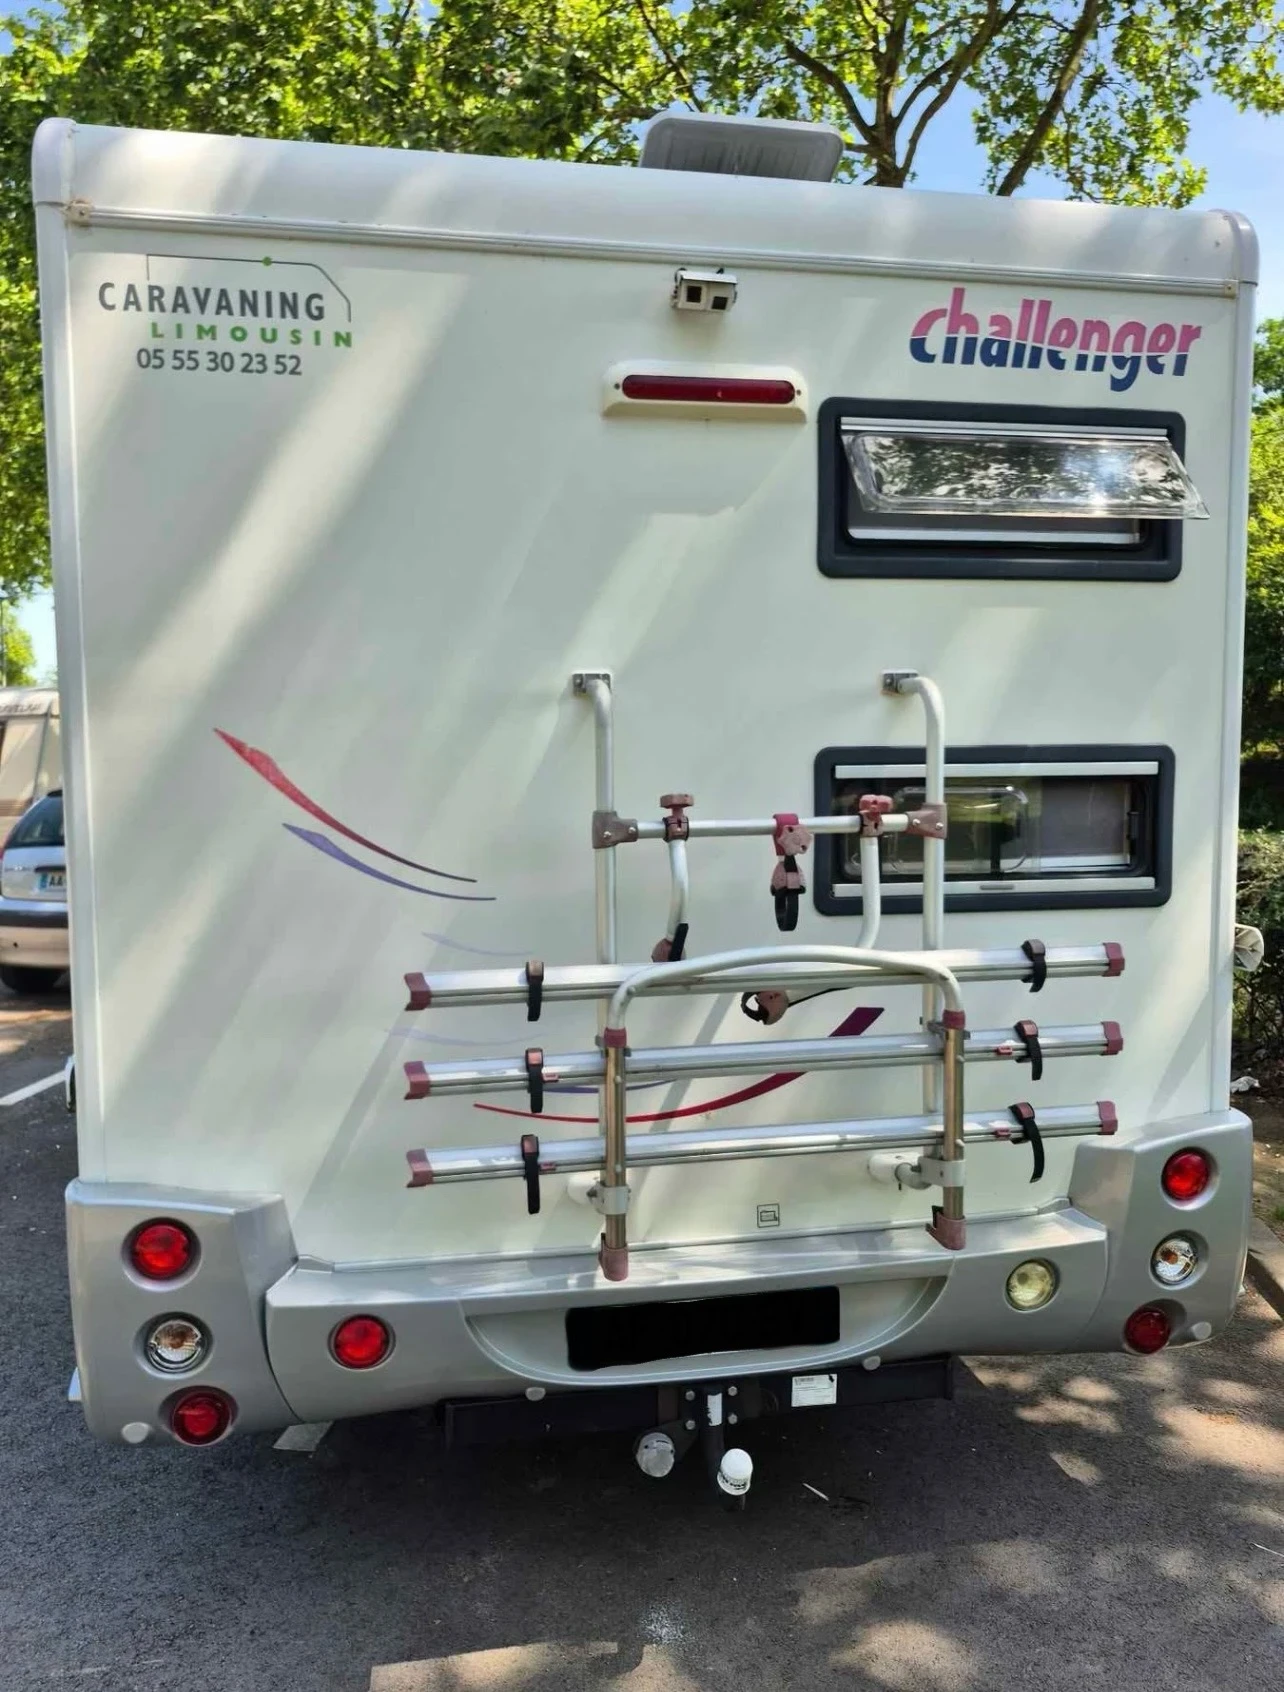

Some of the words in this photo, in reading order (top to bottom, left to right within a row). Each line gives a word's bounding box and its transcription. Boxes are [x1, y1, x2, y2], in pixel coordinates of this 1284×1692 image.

[98, 282, 326, 321] CARAVANING
[151, 321, 352, 348] LIMOUSIN
[909, 287, 1202, 392] challenger
[136, 348, 165, 370] 05
[171, 349, 200, 371] 55
[206, 350, 235, 373] 30
[240, 352, 268, 374] 23
[274, 354, 302, 376] 52
